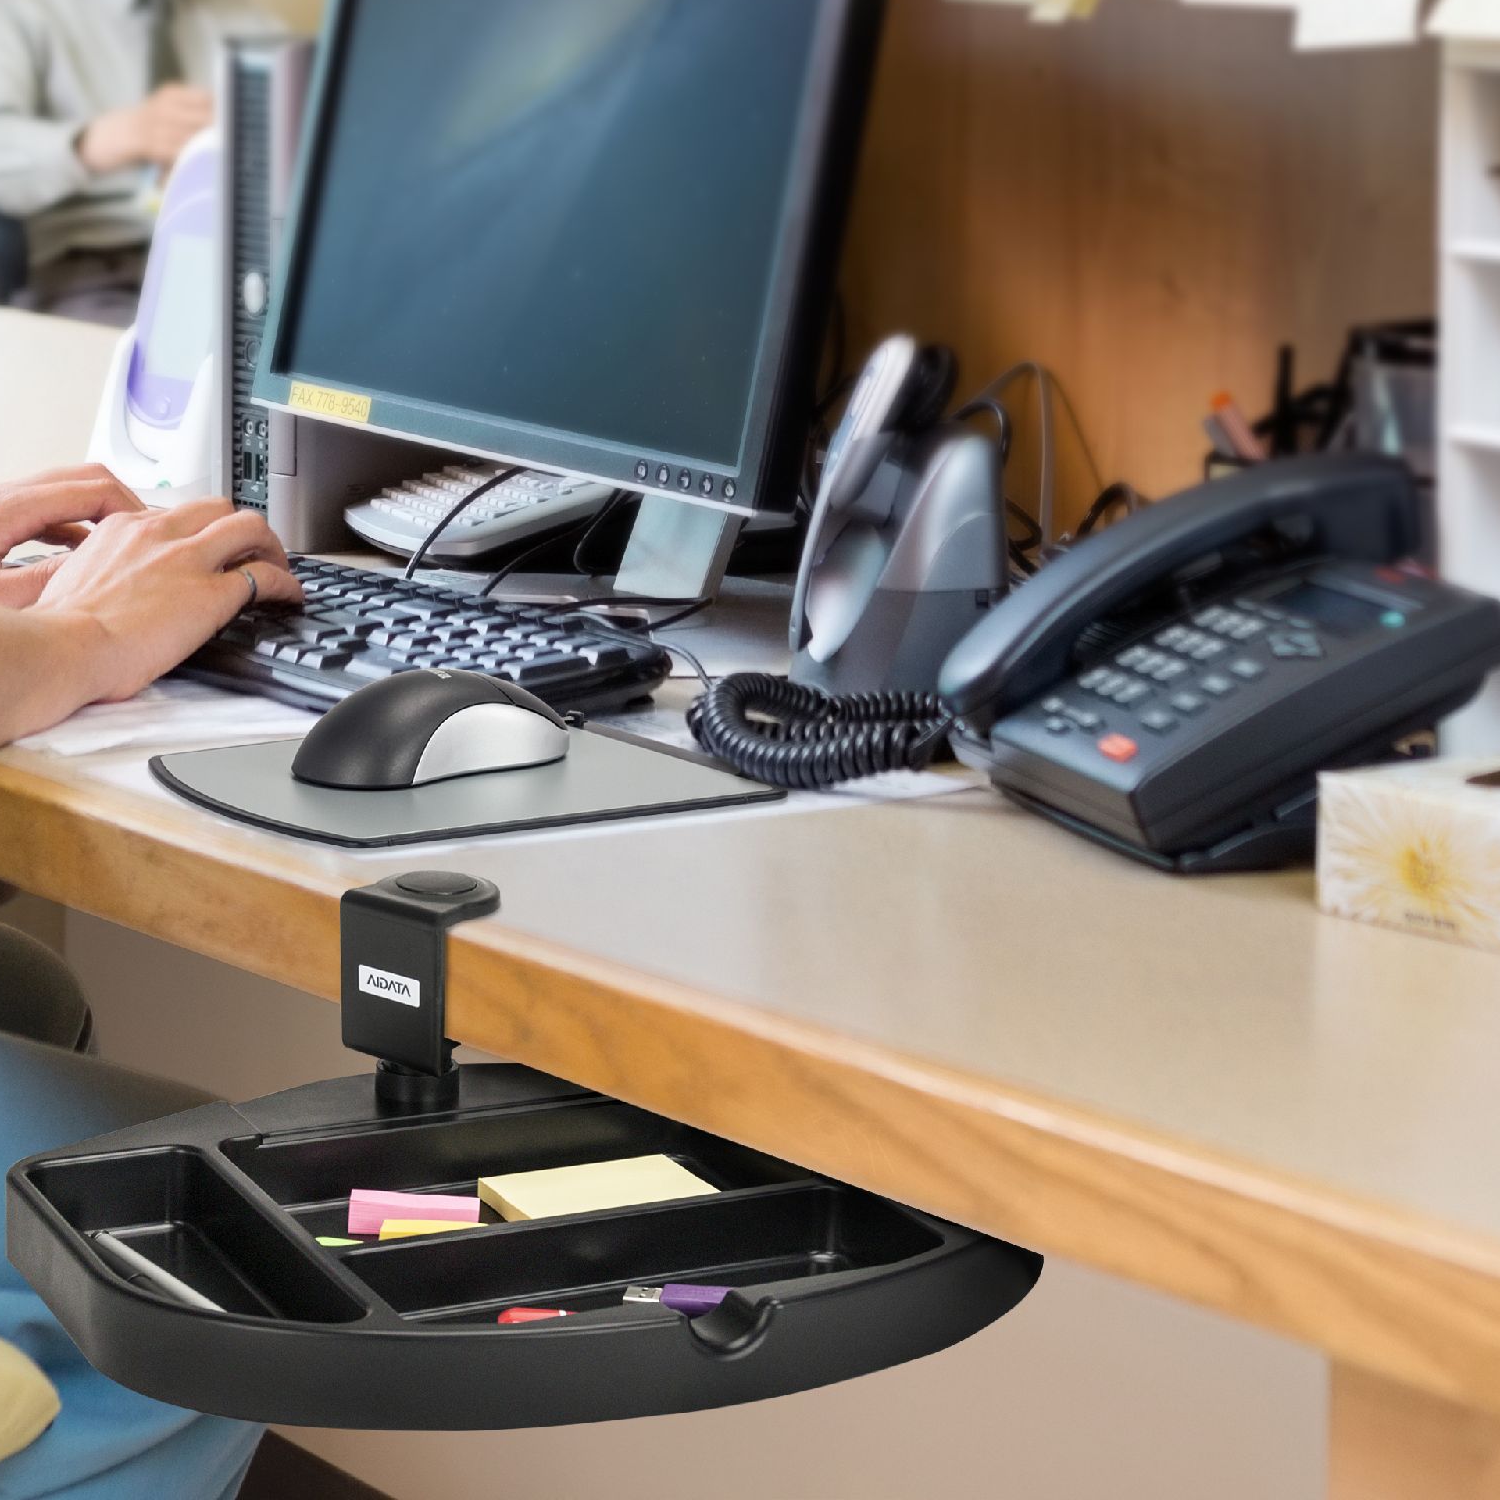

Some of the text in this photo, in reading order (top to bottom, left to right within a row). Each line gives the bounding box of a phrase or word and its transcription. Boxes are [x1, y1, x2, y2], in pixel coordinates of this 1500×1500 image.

[291, 386, 368, 418] FAX 778-9540
[366, 974, 412, 998] AIDATA
